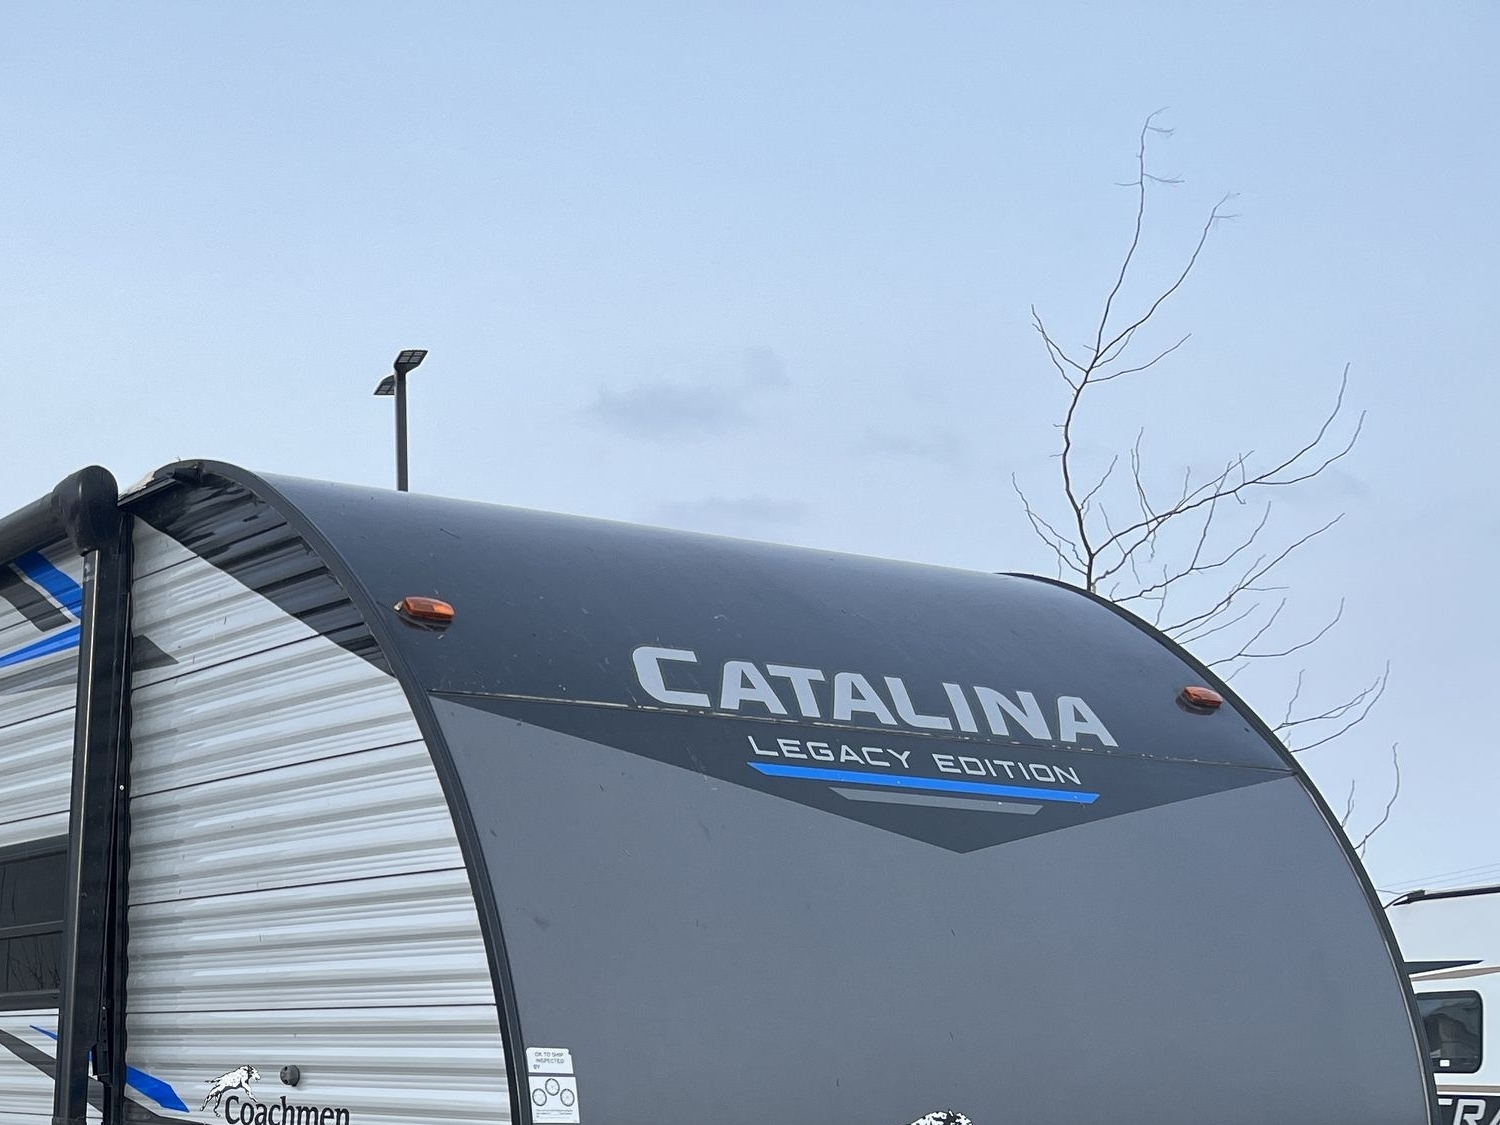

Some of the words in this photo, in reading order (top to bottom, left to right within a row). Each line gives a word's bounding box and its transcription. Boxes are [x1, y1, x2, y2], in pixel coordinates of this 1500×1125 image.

[631, 645, 1119, 748] CATALINA
[747, 735, 912, 769] LEGACY
[932, 752, 1082, 785] EDITION
